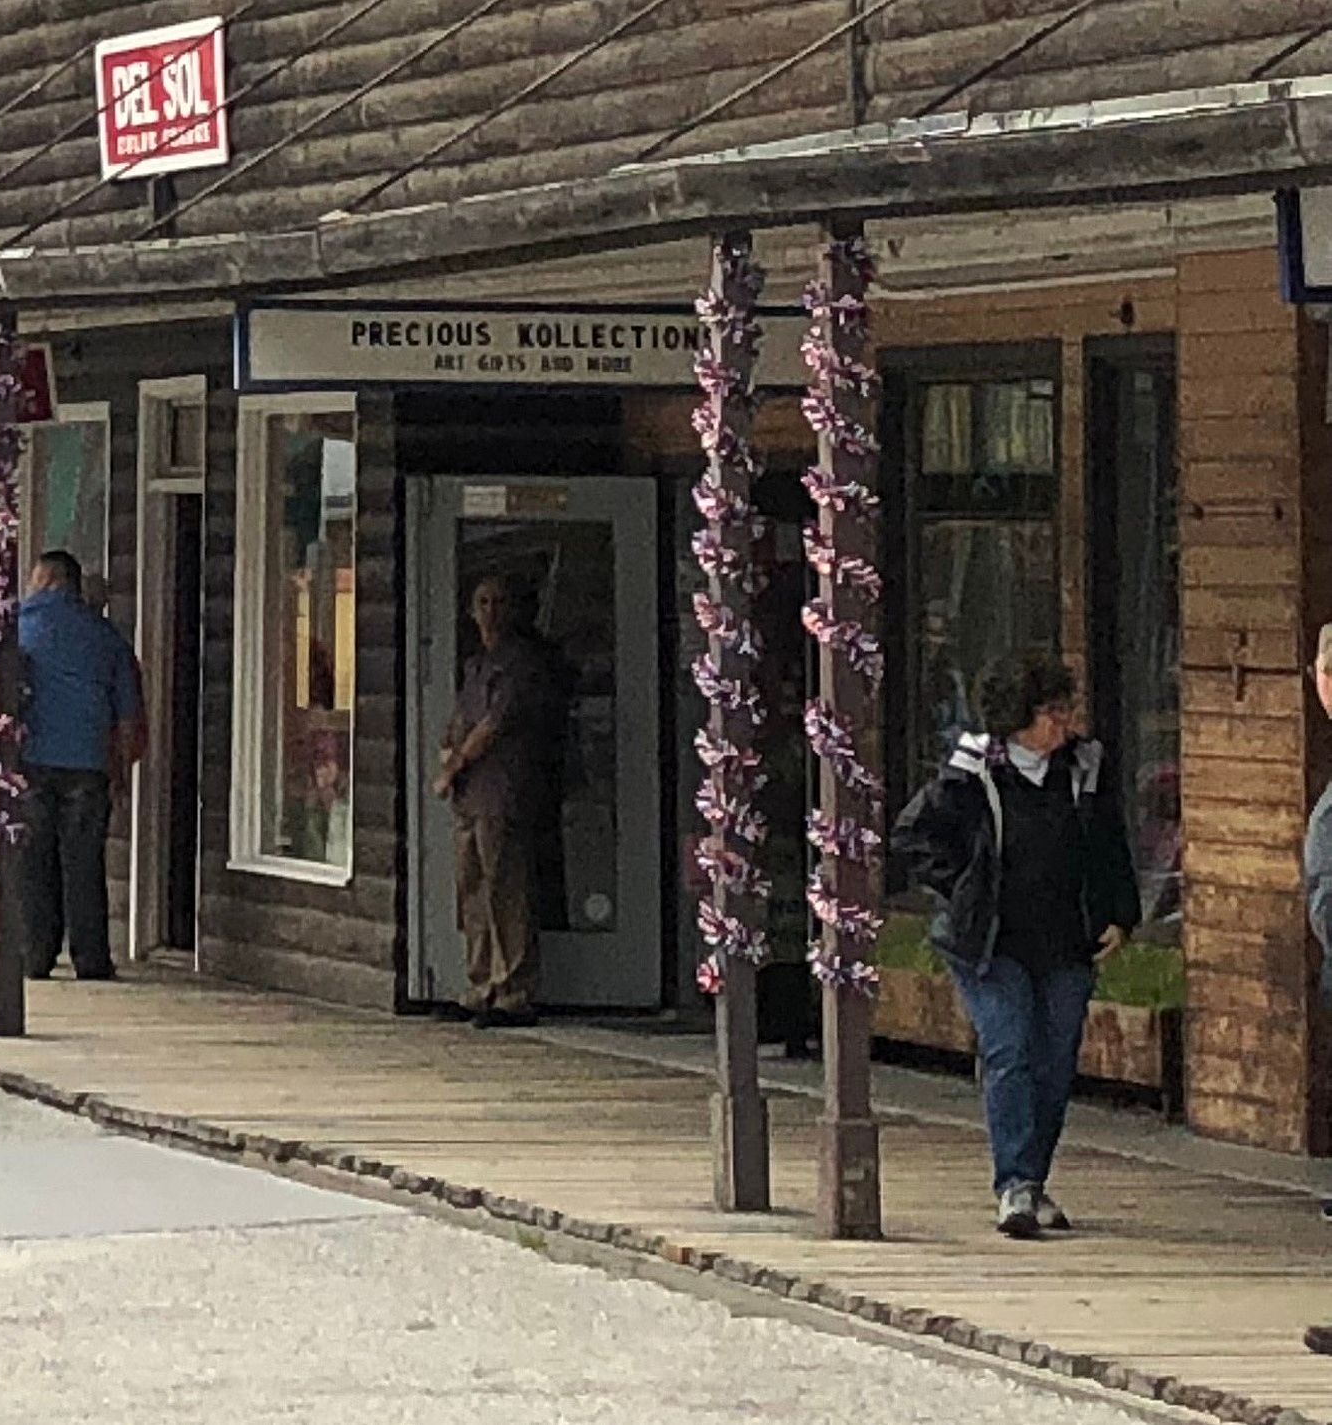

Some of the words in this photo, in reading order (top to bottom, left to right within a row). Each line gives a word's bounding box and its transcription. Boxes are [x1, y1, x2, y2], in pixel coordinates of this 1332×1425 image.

[112, 62, 159, 129] DEL
[163, 49, 210, 120] SOL
[352, 321, 492, 346] PRECIOUS
[436, 354, 465, 371] ART
[478, 355, 527, 372] GIFTS
[541, 355, 574, 373] AND
[588, 356, 632, 373] MORE
